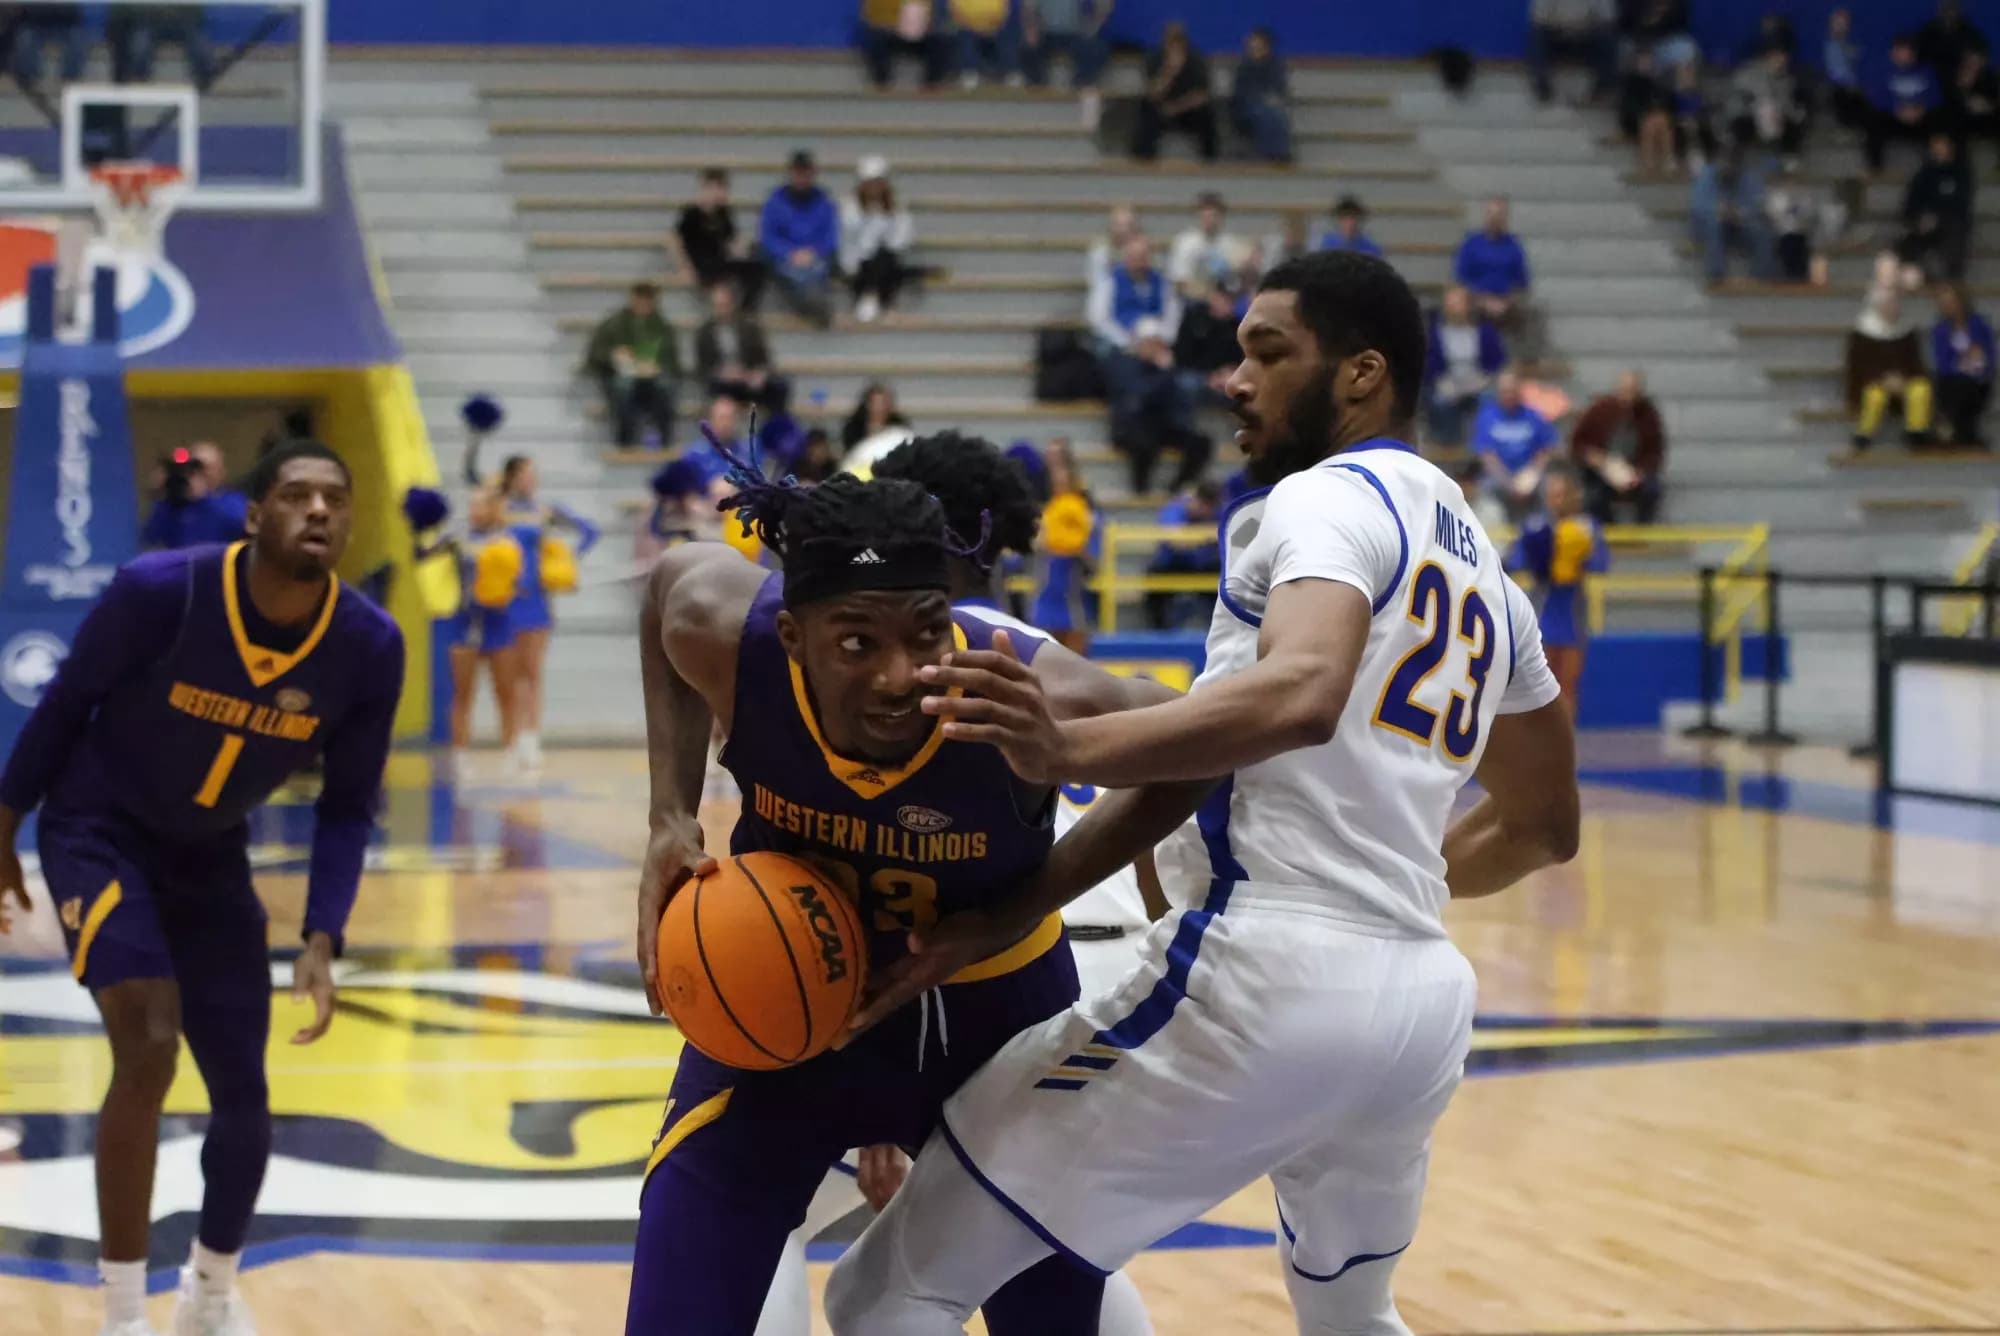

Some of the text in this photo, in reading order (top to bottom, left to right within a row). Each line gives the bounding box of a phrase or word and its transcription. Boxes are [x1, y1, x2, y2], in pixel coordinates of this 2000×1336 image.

[1435, 500, 1477, 568] MILES
[1371, 559, 1495, 762] 23
[168, 680, 251, 727] WESTERN
[193, 733, 245, 809] 1
[754, 783, 988, 863] WESTERN ILLINOIS
[788, 885, 848, 984] NCAA
